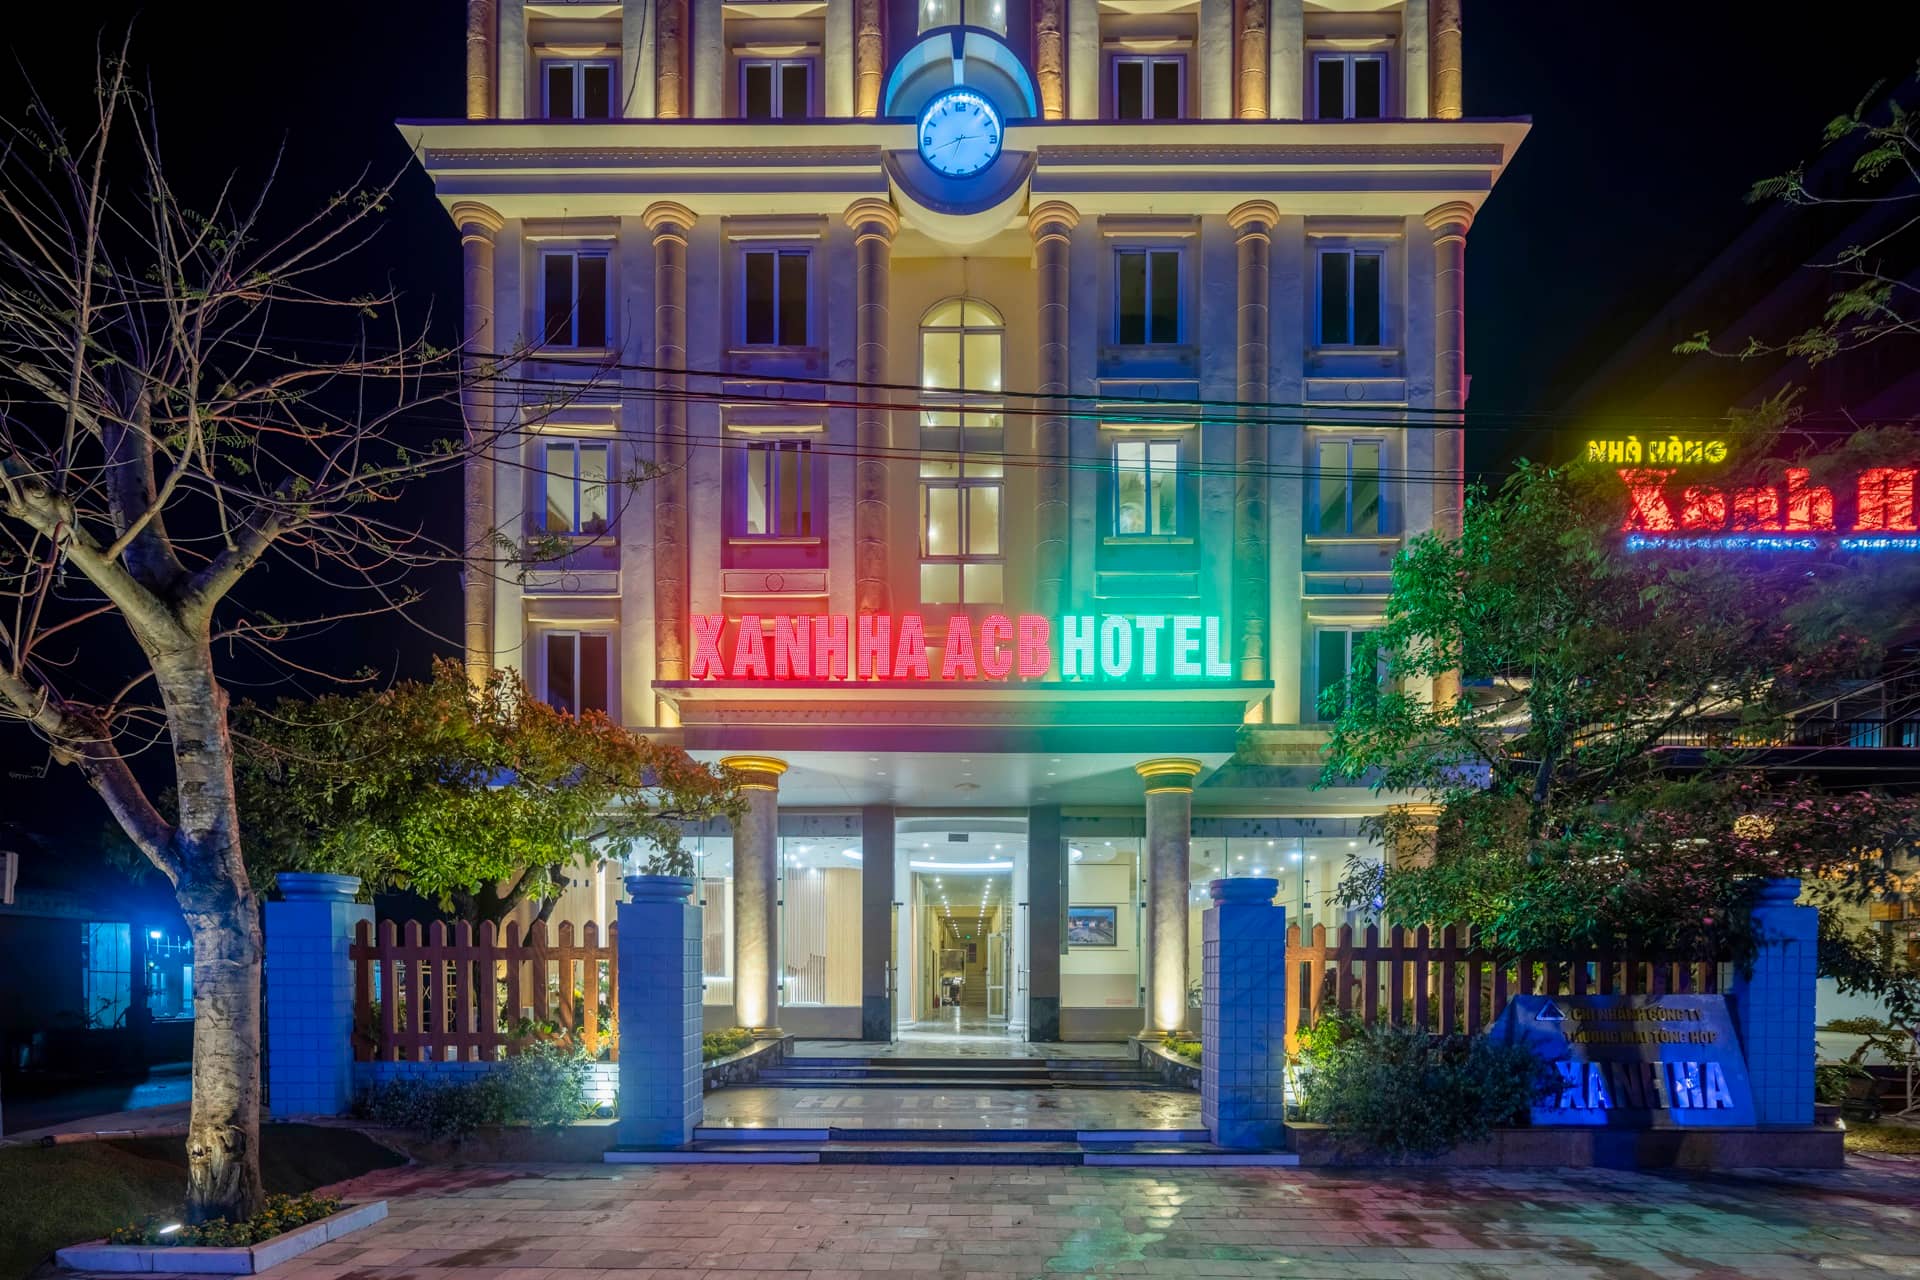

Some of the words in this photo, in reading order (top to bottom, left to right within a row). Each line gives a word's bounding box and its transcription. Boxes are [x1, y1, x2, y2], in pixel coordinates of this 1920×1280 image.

[955, 102, 966, 112] 12
[989, 135, 997, 144] 3
[941, 614, 1051, 679] ACB
[1062, 615, 1232, 677] HOTEL
